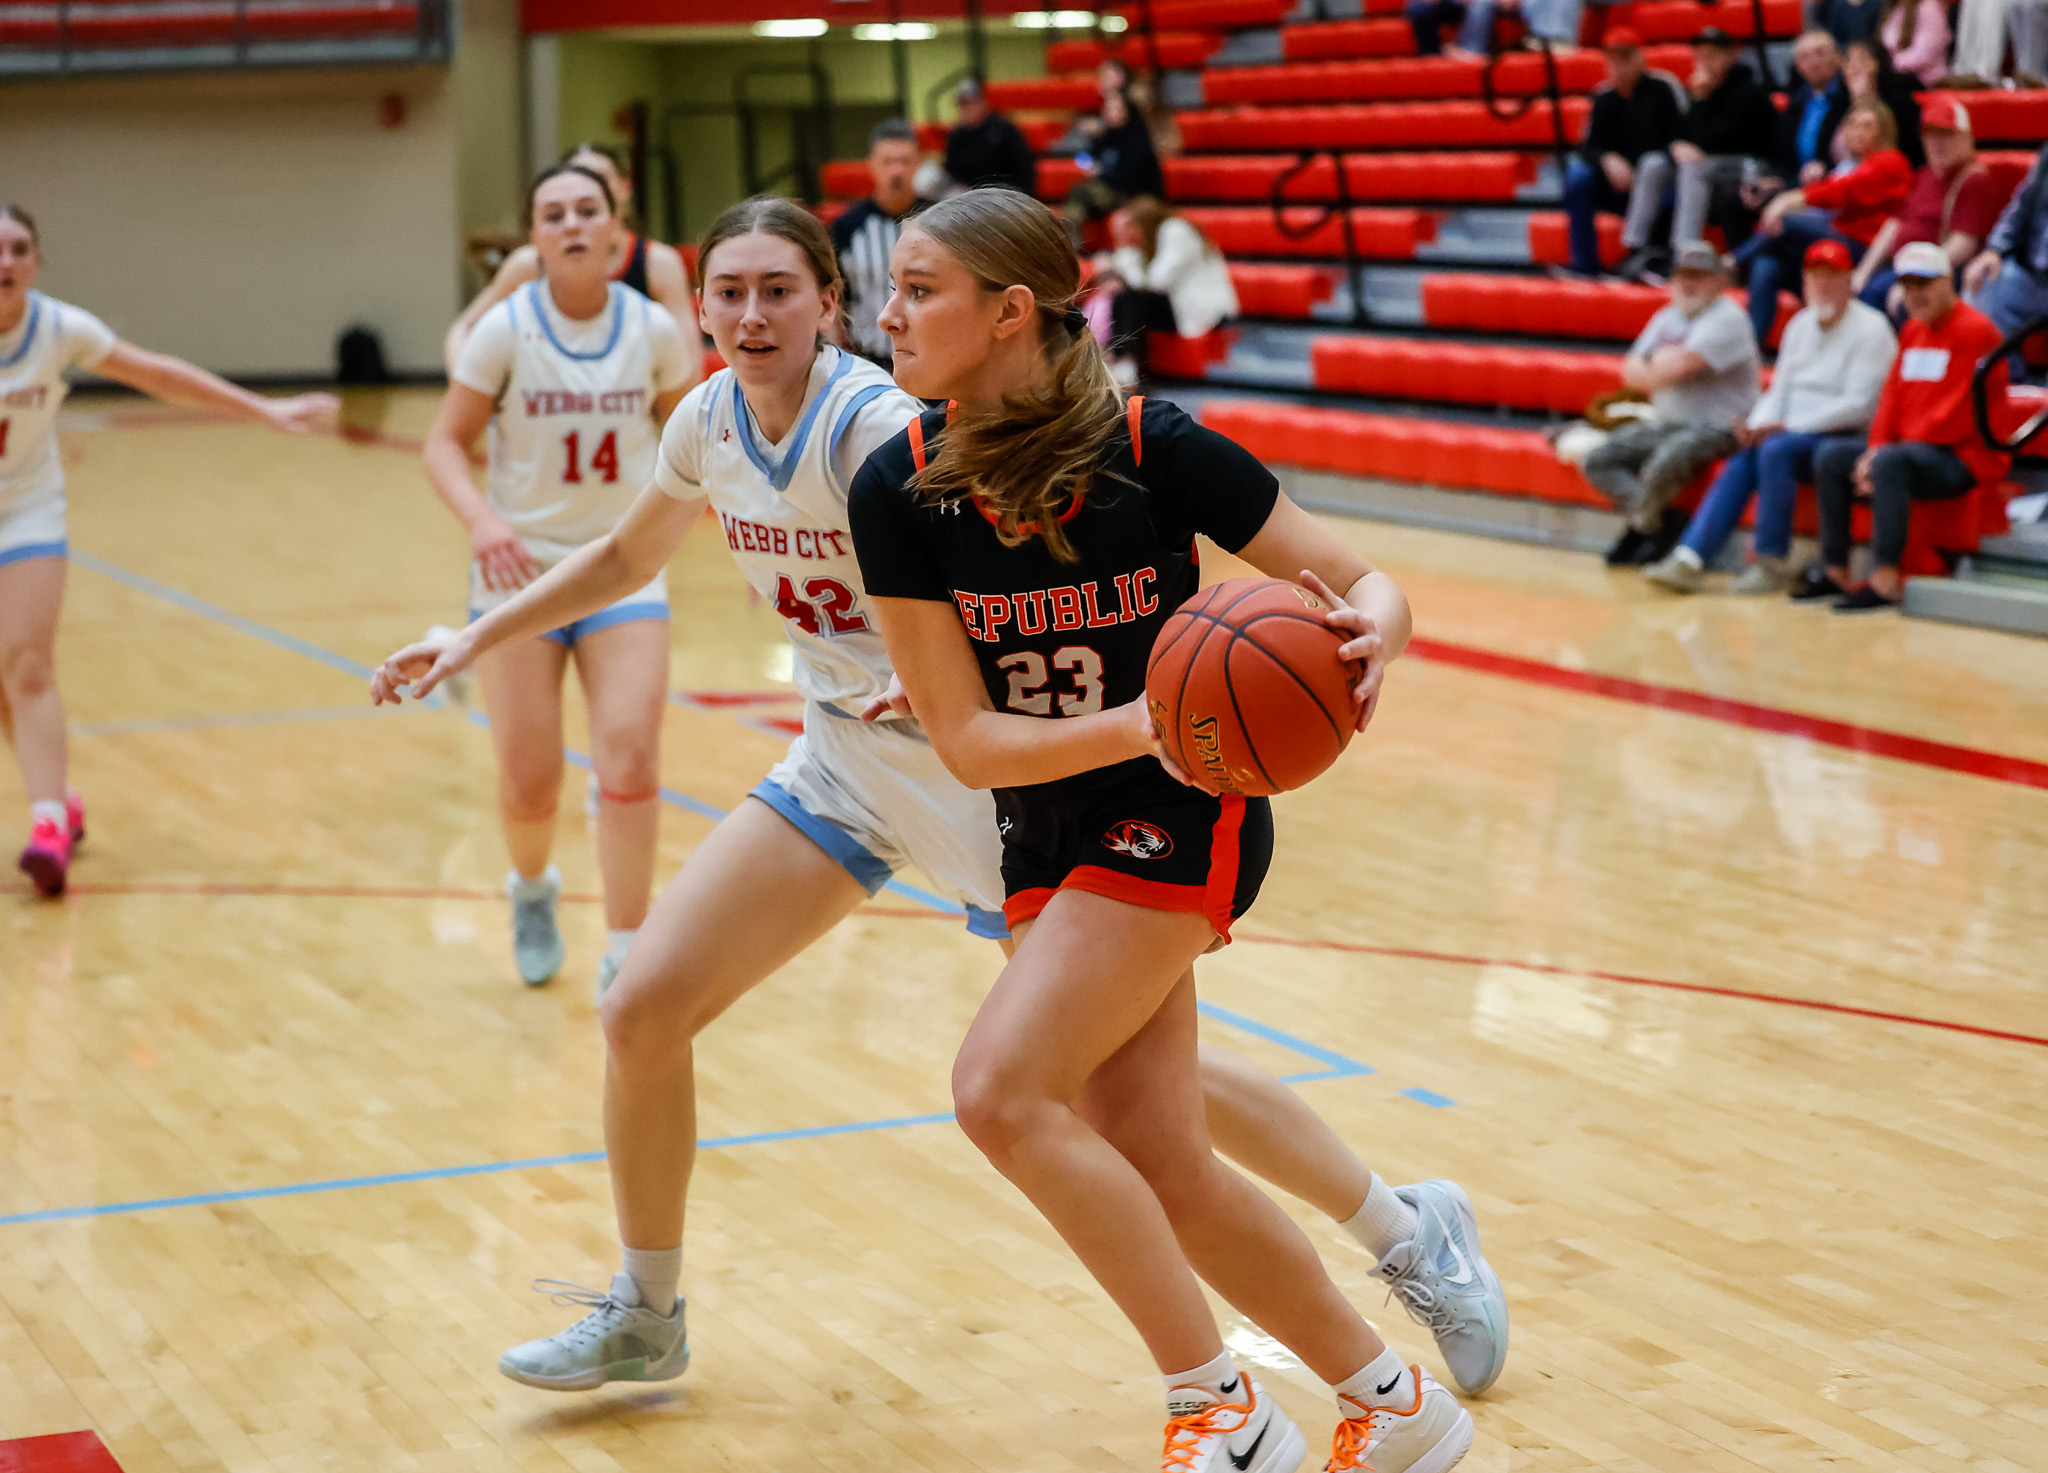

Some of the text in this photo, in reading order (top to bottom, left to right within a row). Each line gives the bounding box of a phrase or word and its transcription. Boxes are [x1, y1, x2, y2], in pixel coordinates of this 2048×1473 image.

[561, 428, 620, 485] 14
[721, 512, 848, 560] WEBB CIT
[773, 571, 869, 637] 42
[952, 566, 1159, 642] EPUBLIC
[995, 644, 1106, 718] 23
